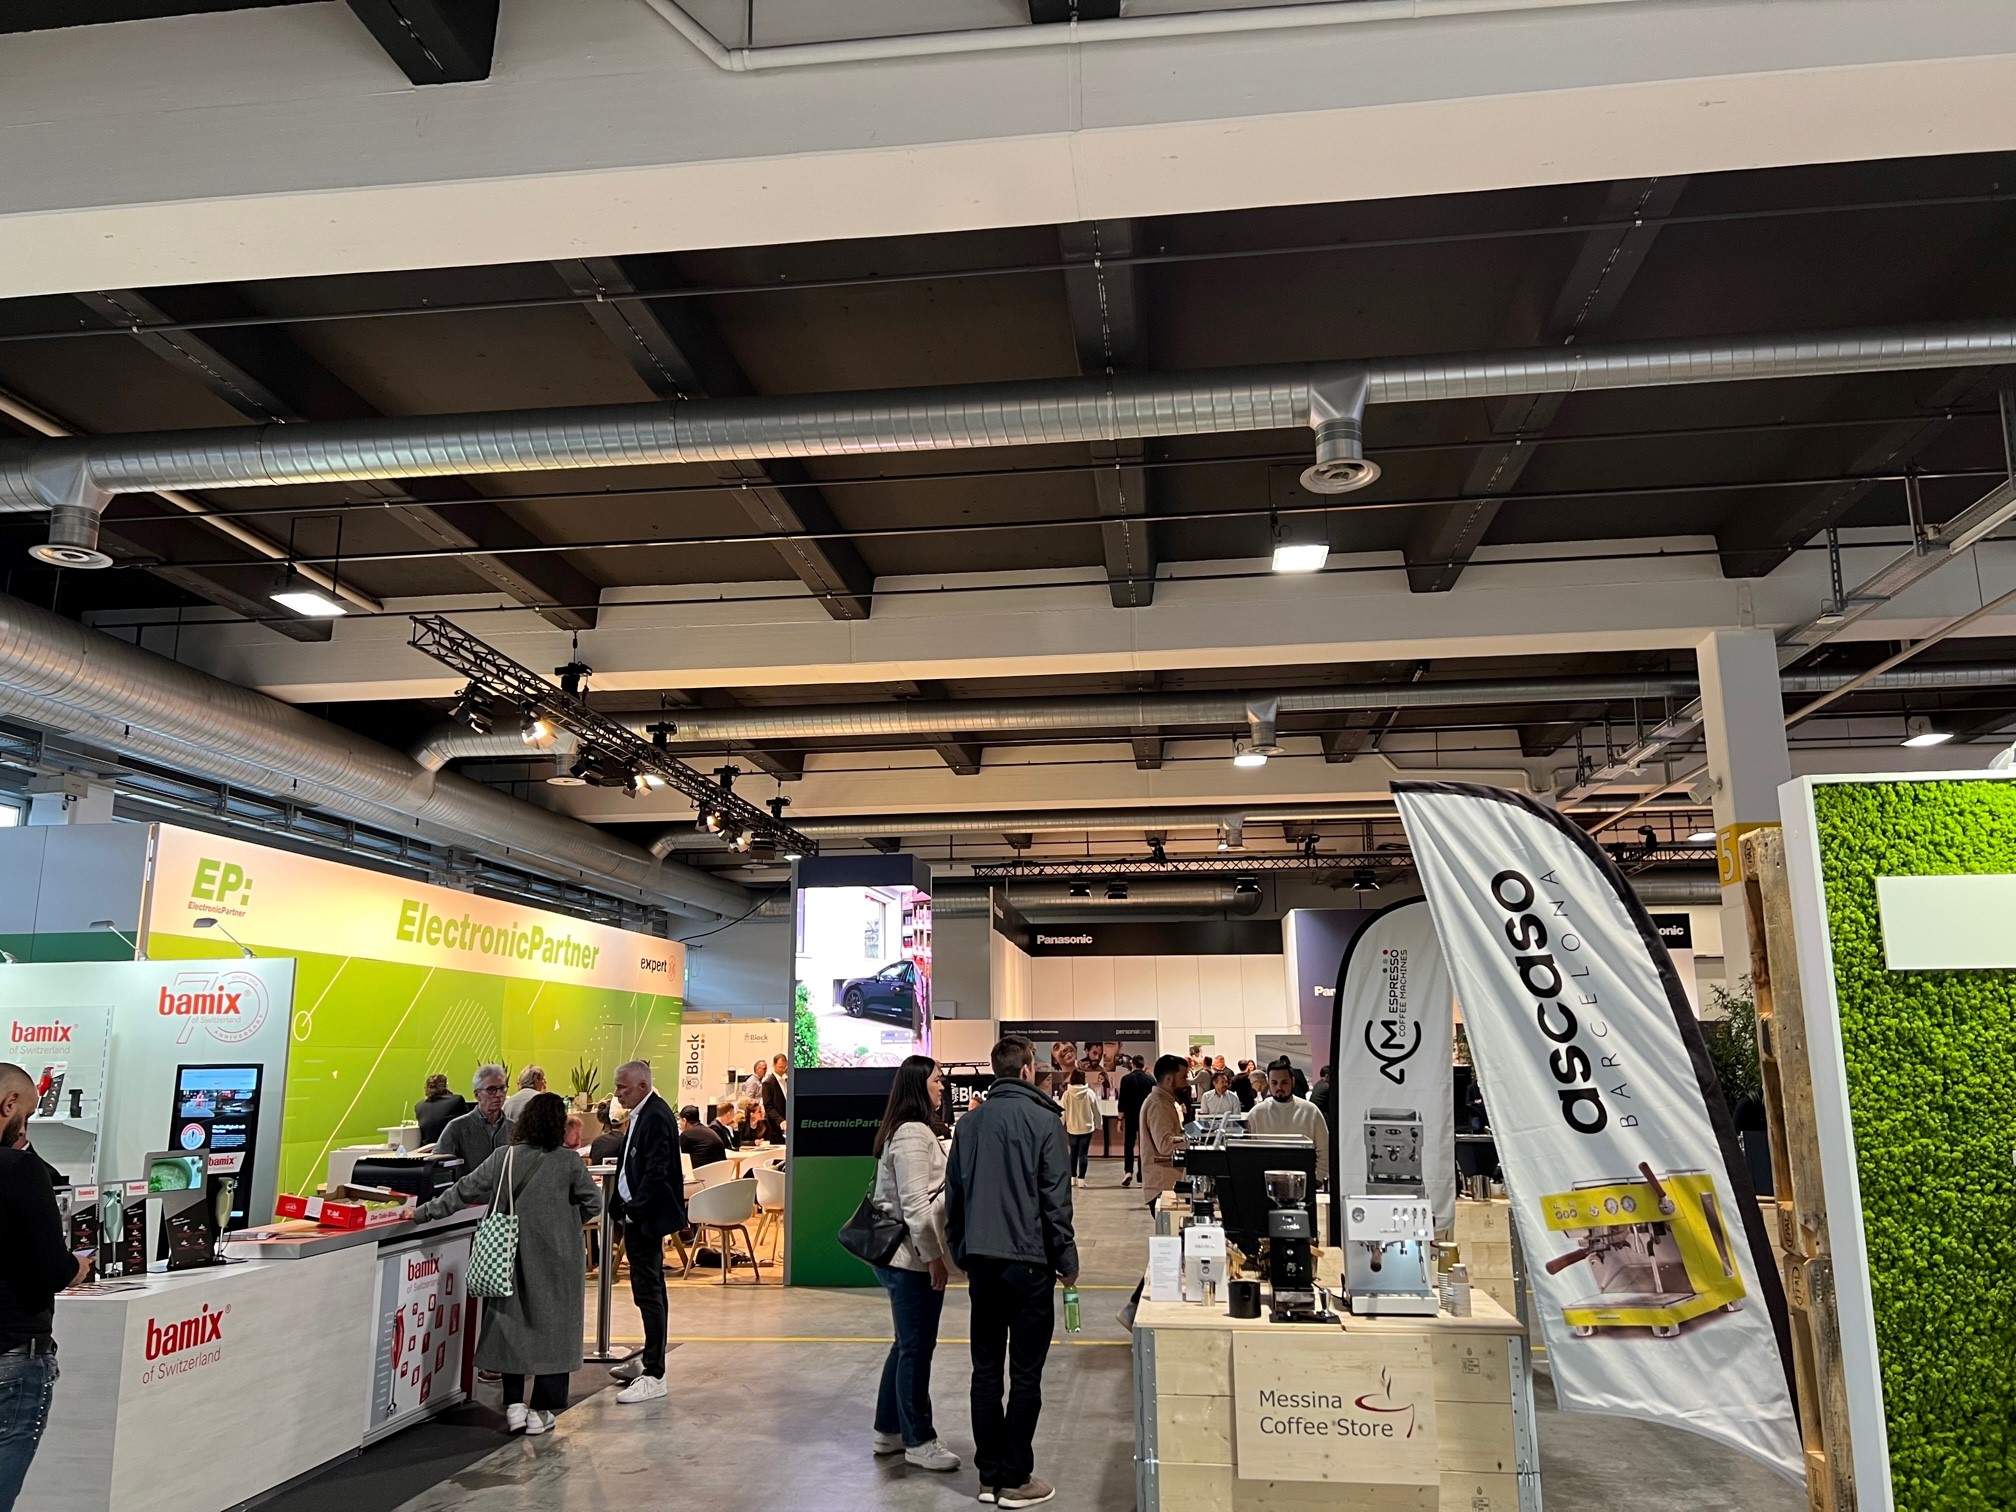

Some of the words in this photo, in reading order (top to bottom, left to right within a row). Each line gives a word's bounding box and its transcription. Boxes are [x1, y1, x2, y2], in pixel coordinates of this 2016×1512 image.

[1721, 831, 1734, 881] 5
[191, 857, 253, 906] EP:
[188, 901, 246, 917] ElectronicPartner
[396, 899, 600, 970] ElectronicPartner
[1037, 934, 1093, 944] Panasonic
[640, 956, 667, 974] expert
[1400, 949, 1408, 998] MACHINES
[1389, 949, 1399, 1013] ESPRESSO
[159, 985, 242, 1015] bamix
[1491, 870, 1607, 1134] ascaso
[1540, 870, 1639, 1128] BARCELONA
[11, 1020, 72, 1043] bamix
[200, 1016, 241, 1024] Switzerland
[1399, 1000, 1407, 1037] COFFEE
[9, 1046, 18, 1055] of
[20, 1045, 71, 1055] Switzerland
[750, 1033, 768, 1041] Block
[686, 1034, 699, 1074] Block
[959, 1086, 992, 1103] Bloc
[208, 1156, 234, 1167] bamix
[407, 1252, 440, 1281] bamix
[145, 1303, 224, 1361] bamix
[142, 1366, 154, 1384] of
[157, 1346, 221, 1379] Switzerland
[1259, 1390, 1342, 1409] Messina
[1260, 1416, 1329, 1436] Coffee
[1337, 1418, 1394, 1437] Store
